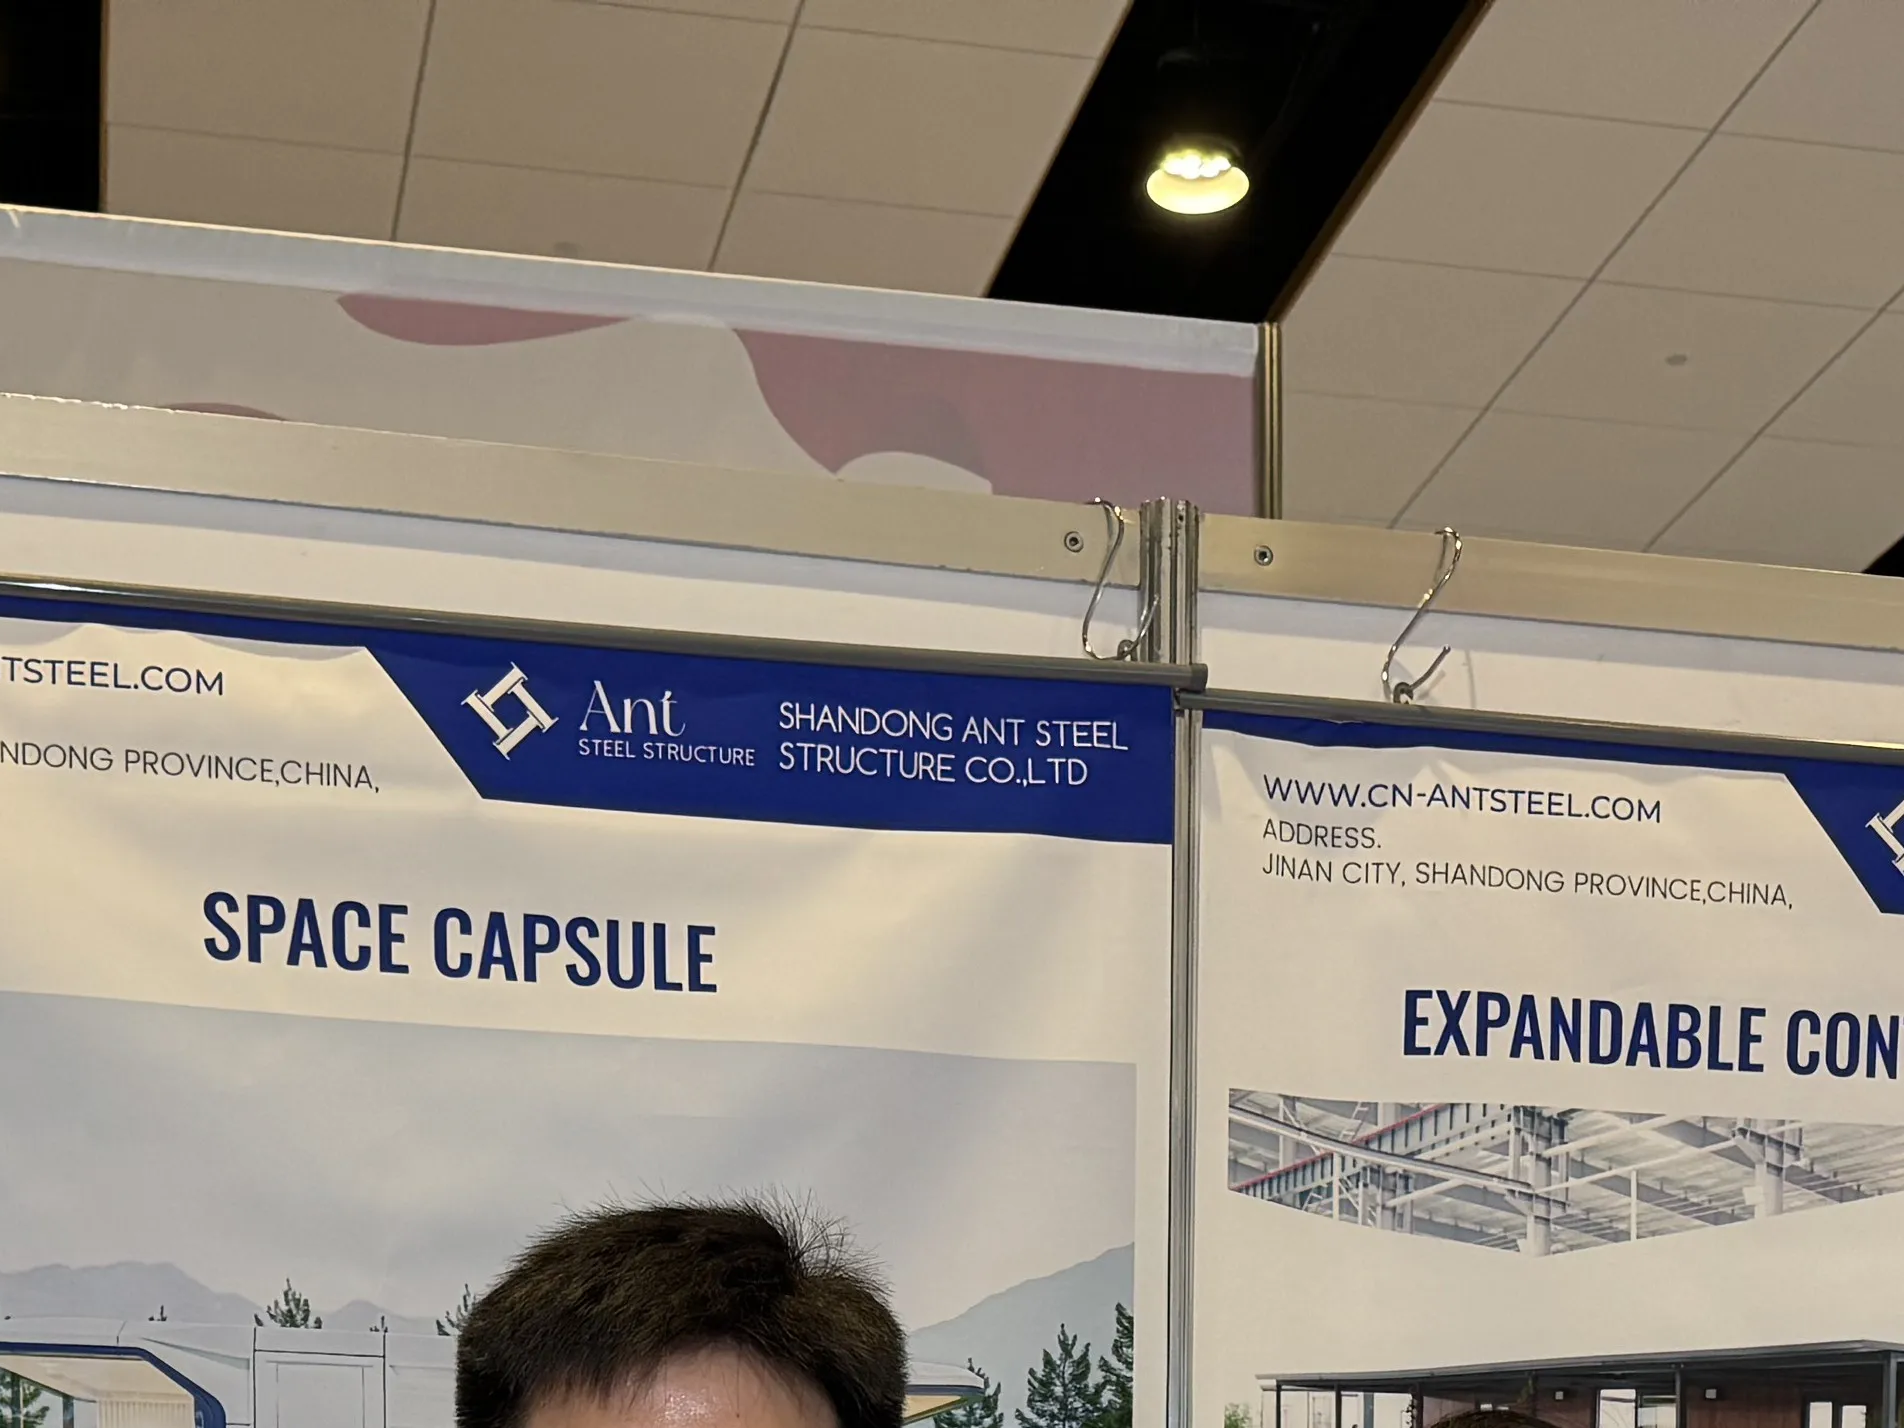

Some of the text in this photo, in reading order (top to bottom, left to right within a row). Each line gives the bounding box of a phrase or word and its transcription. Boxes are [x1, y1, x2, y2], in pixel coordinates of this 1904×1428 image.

[579, 680, 686, 737] Ant
[778, 701, 1129, 751] SHANDONG ANT STEEL
[123, 749, 381, 794] PROVINCE,CHINA,
[578, 737, 756, 767] STEEL STRUCTURE
[778, 742, 956, 784] STRUCTURE
[1263, 774, 1661, 824] WWW.CN-ANTSTEEL.COM
[1262, 853, 1793, 909] JINAN CITY, SHANDONG PROVINCE,CHINA,
[203, 891, 719, 995] SPACE CAPSULE
[1402, 989, 1764, 1074] EXPANDABLE
